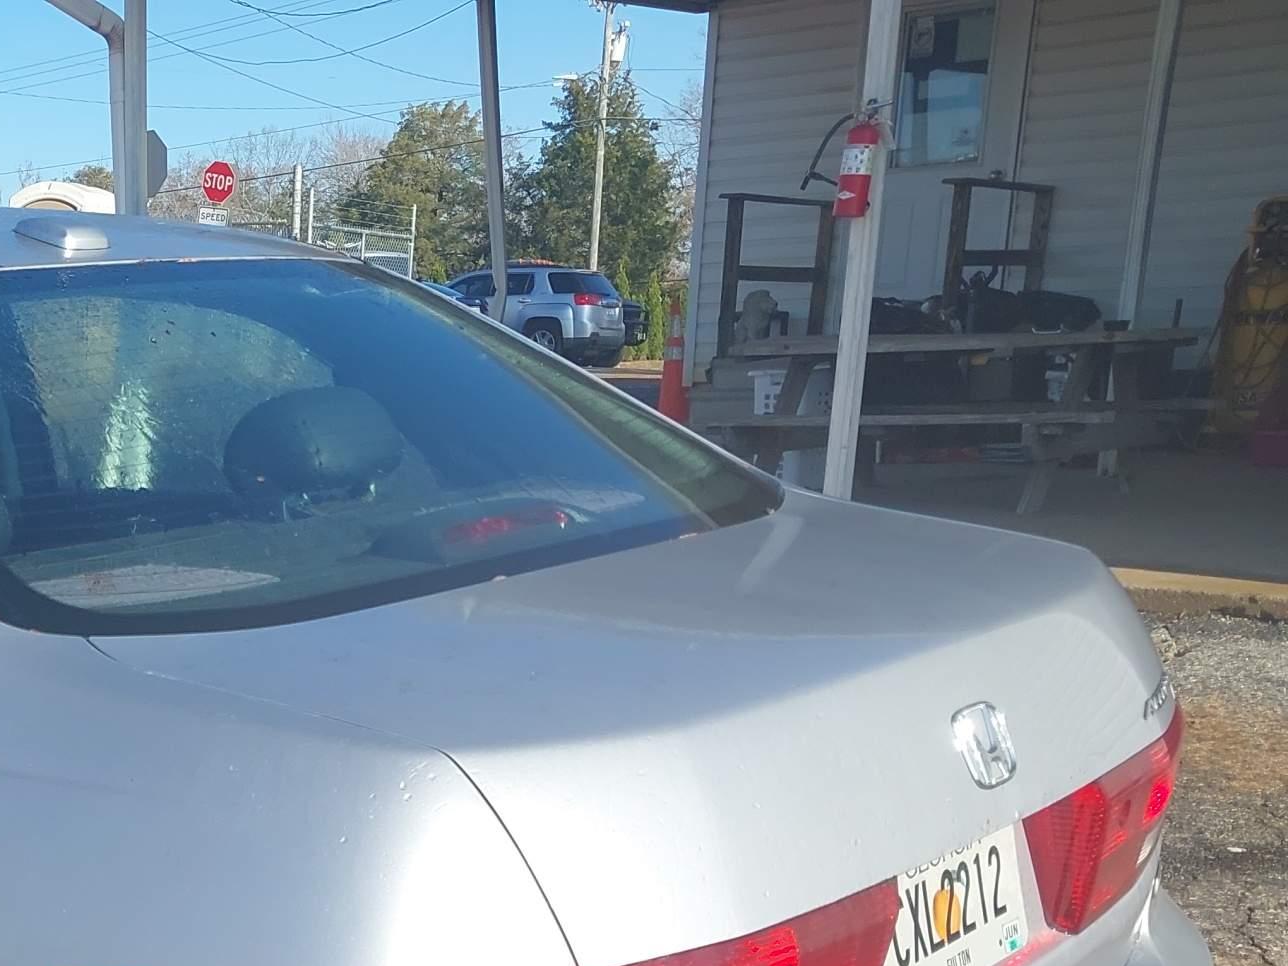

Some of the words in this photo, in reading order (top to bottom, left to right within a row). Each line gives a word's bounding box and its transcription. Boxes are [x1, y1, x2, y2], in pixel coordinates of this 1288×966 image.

[205, 173, 233, 191] STOP
[201, 212, 226, 222] SPEED
[1004, 922, 1019, 941] JUN
